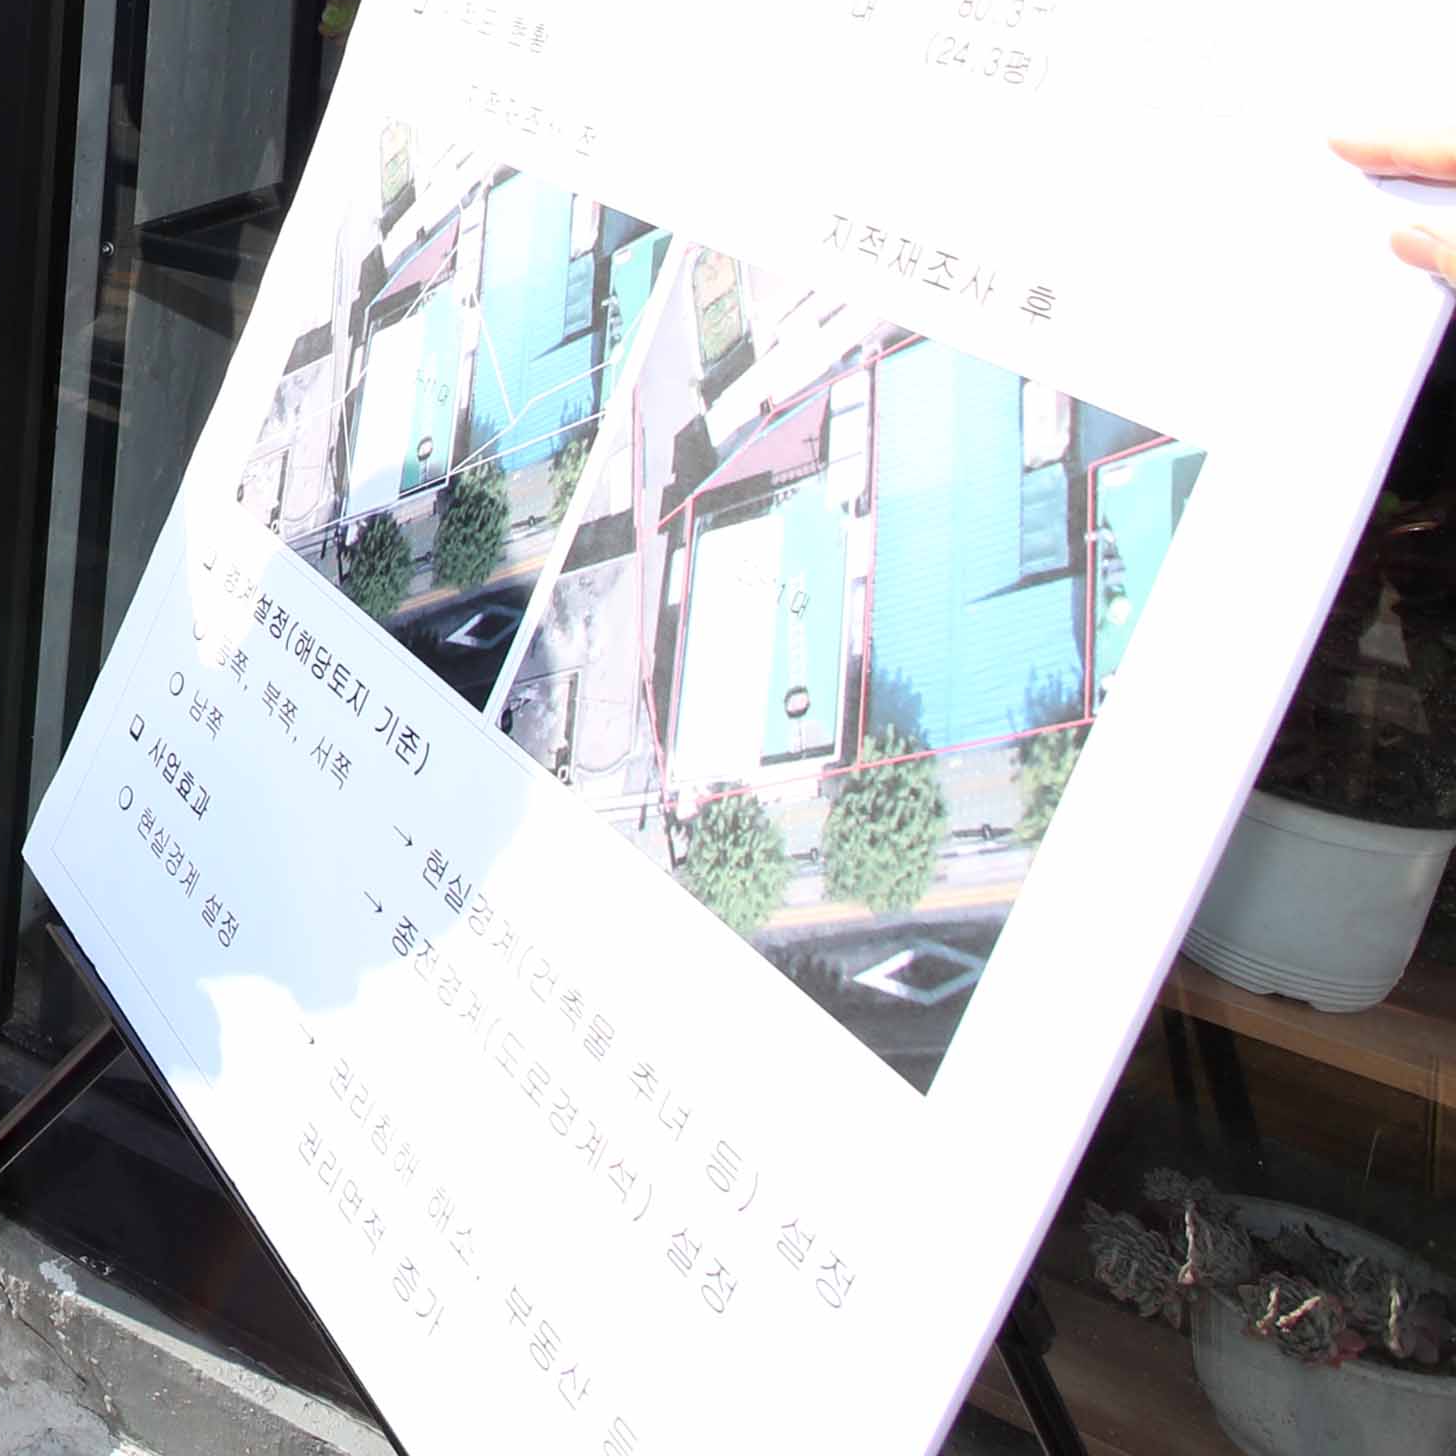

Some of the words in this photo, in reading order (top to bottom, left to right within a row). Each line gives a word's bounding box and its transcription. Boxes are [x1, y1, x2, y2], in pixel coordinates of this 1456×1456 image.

[821, 211, 998, 308] 지적재조사
[1018, 284, 1057, 327] 후
[146, 736, 213, 823] 사업효과
[374, 704, 433, 777] 기준)
[260, 680, 300, 744] 북쪽,
[309, 735, 354, 791] 서쪽
[419, 847, 616, 1063] 현실경계(건축물
[703, 1138, 760, 1213] 등)
[775, 1217, 856, 1312] 설정
[135, 807, 202, 900] 현실경계
[199, 892, 241, 949] 설정
[328, 1056, 423, 1189] 권리침해
[504, 1282, 592, 1412] 부동산
[390, 912, 655, 1223] 종전경계(도로경계석)
[665, 1226, 740, 1317] 설정
[296, 1120, 387, 1256] 권리면적
[391, 1255, 447, 1336] 증가
